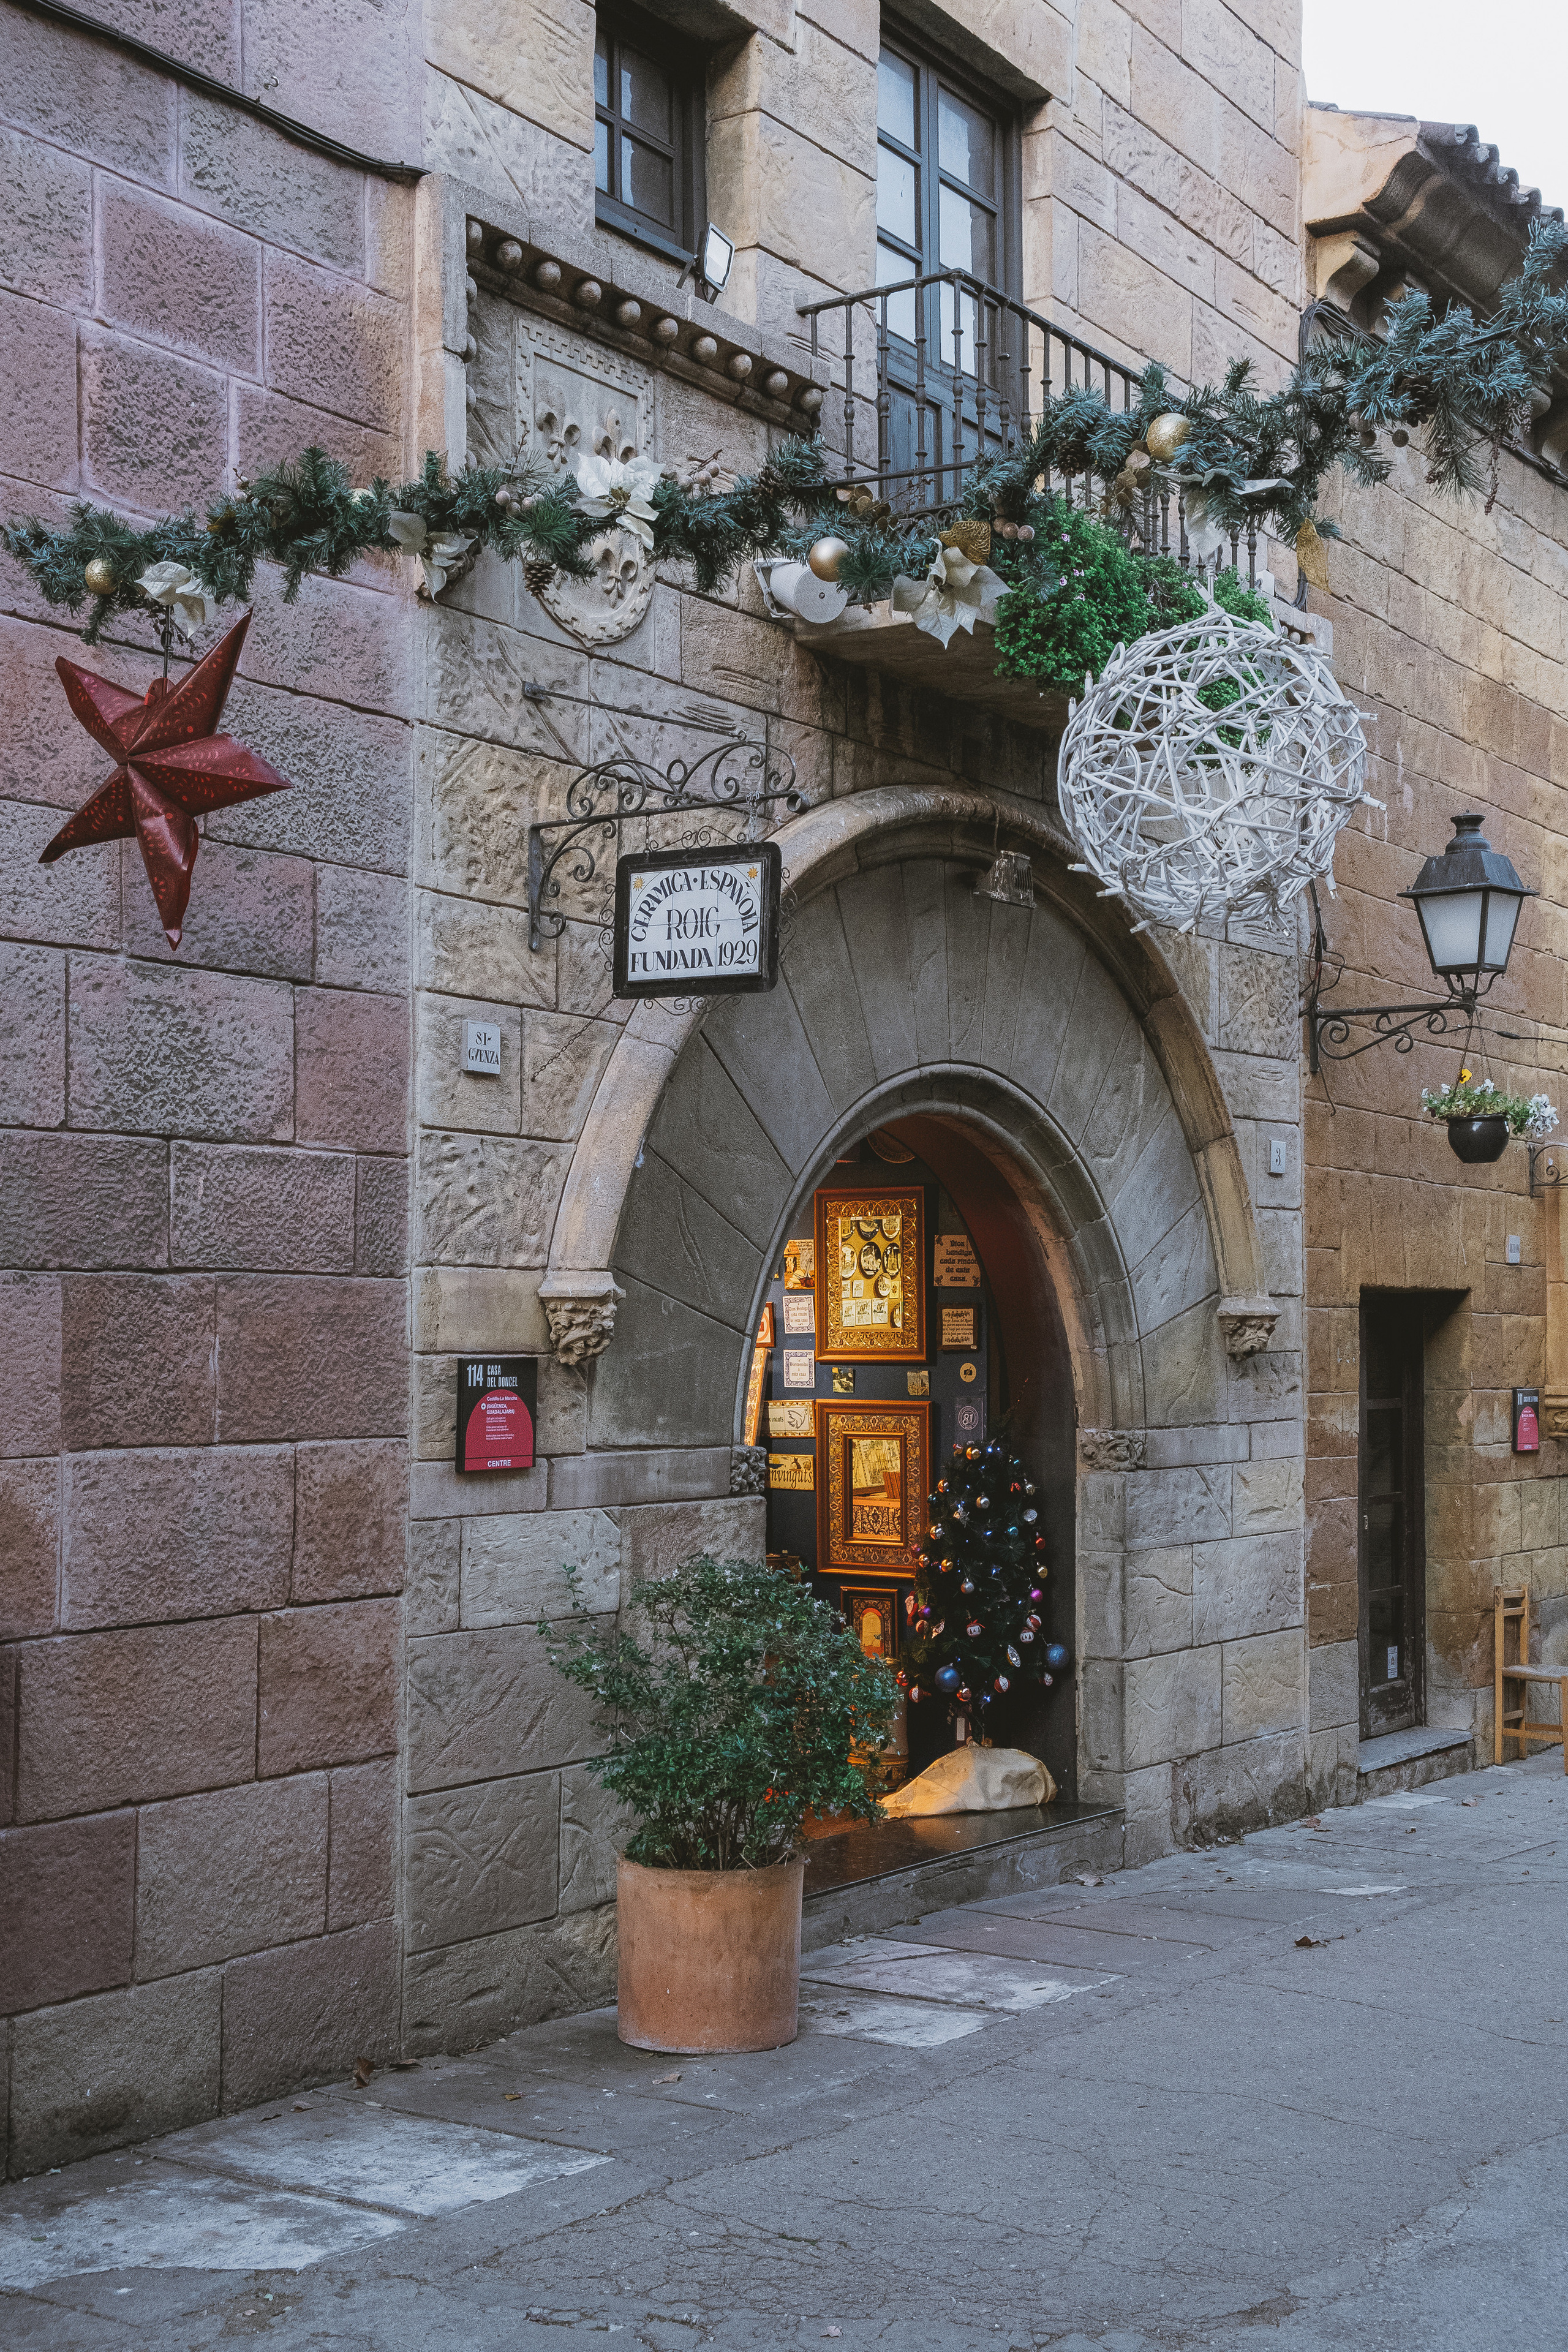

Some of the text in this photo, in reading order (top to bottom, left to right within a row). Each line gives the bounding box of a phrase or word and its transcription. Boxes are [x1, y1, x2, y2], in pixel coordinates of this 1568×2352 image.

[631, 869, 758, 942] CERAMICA ESPAÑOLA
[666, 906, 720, 940] ROIG
[630, 939, 758, 973] FUNDADA 1929
[1276, 1147, 1281, 1166] 3
[467, 1364, 501, 1387] 114 CASA
[487, 1376, 518, 1387] DEL DONCEL
